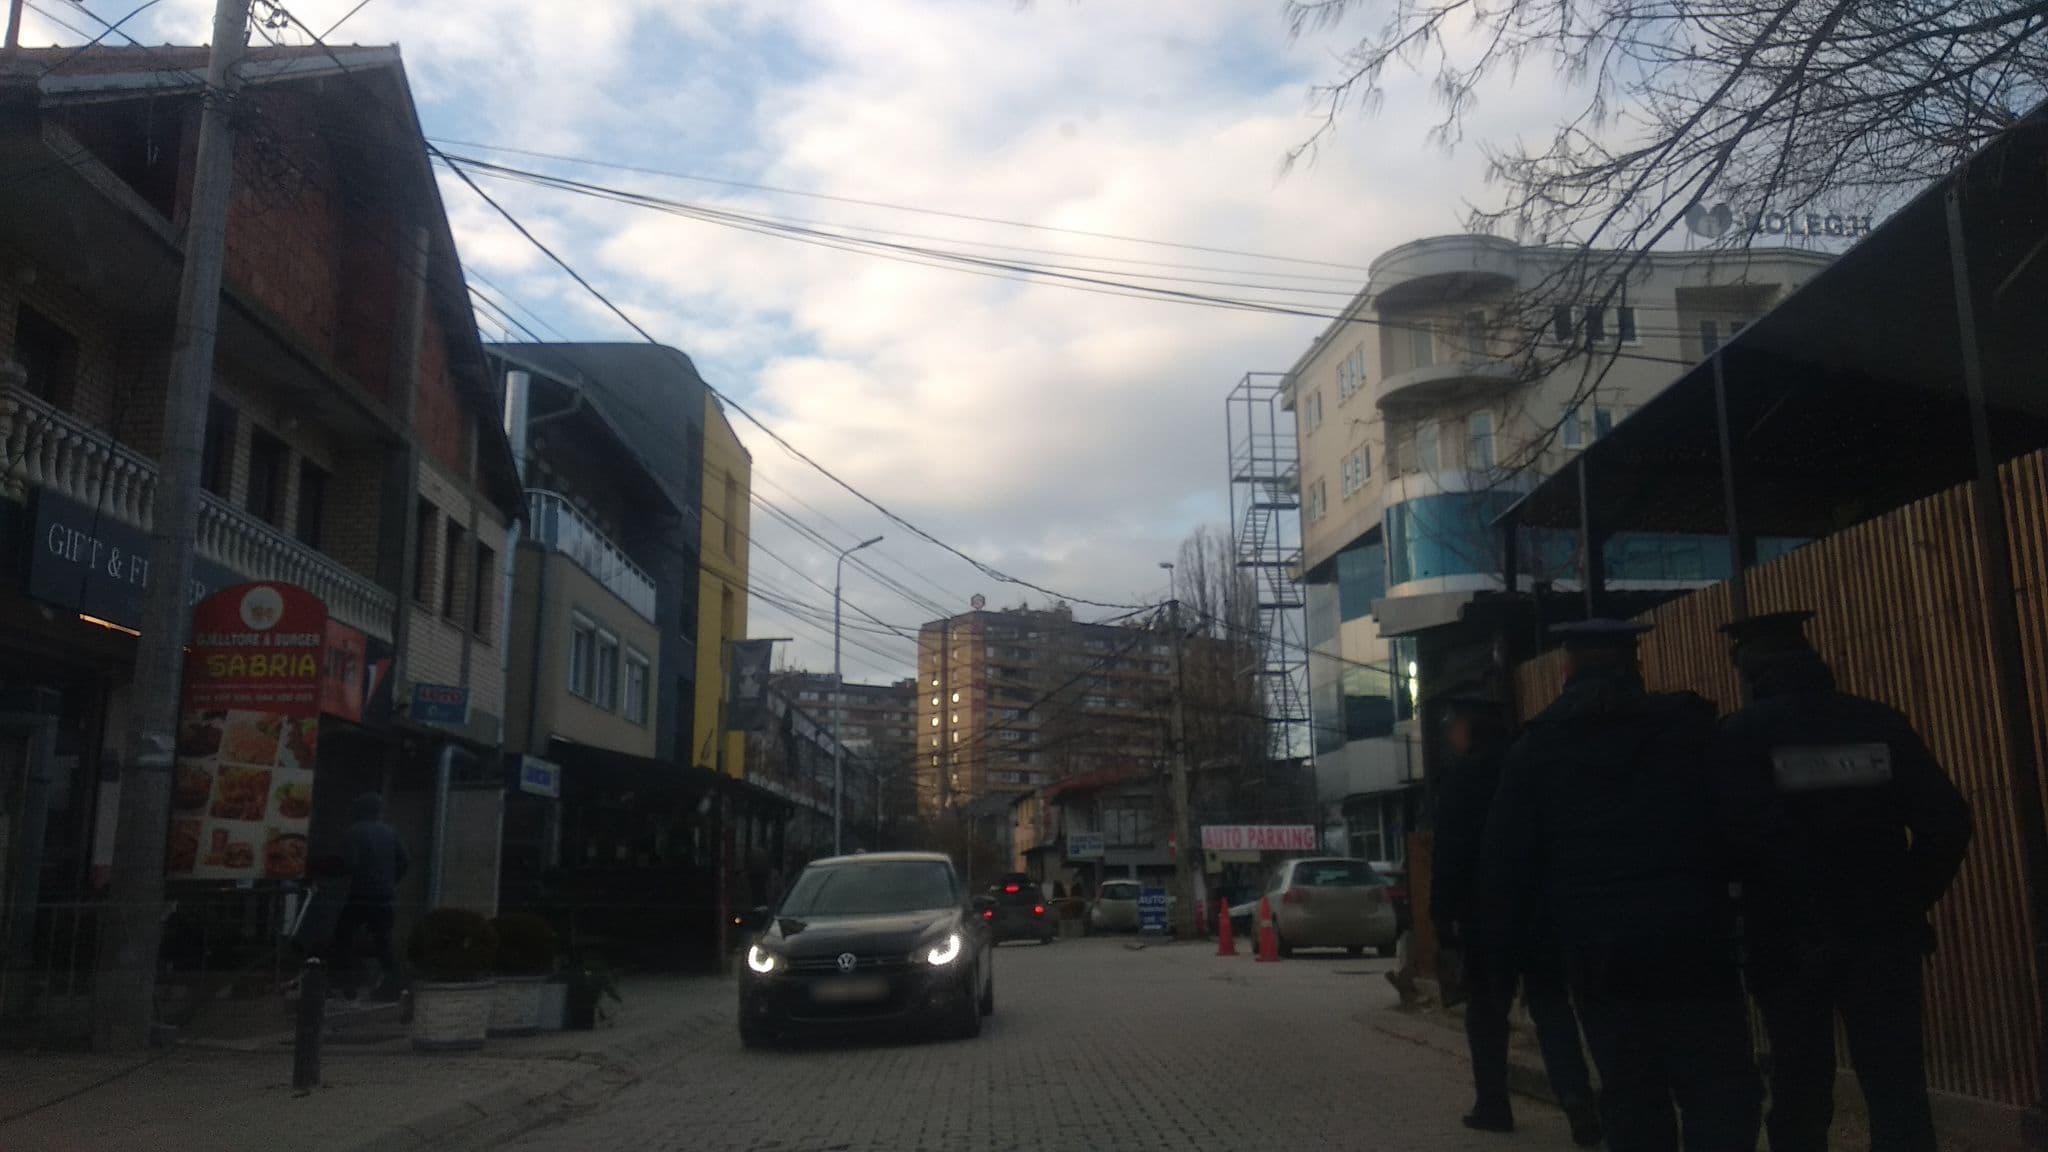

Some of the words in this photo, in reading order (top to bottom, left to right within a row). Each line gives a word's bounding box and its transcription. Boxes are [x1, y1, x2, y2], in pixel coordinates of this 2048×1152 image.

[48, 522, 102, 569] GIFT
[107, 546, 123, 579] &
[207, 653, 318, 678] SABRIA
[1203, 827, 1242, 849] AUTO
[1247, 827, 1314, 849] PARKING
[1138, 895, 1166, 905] AUTO
